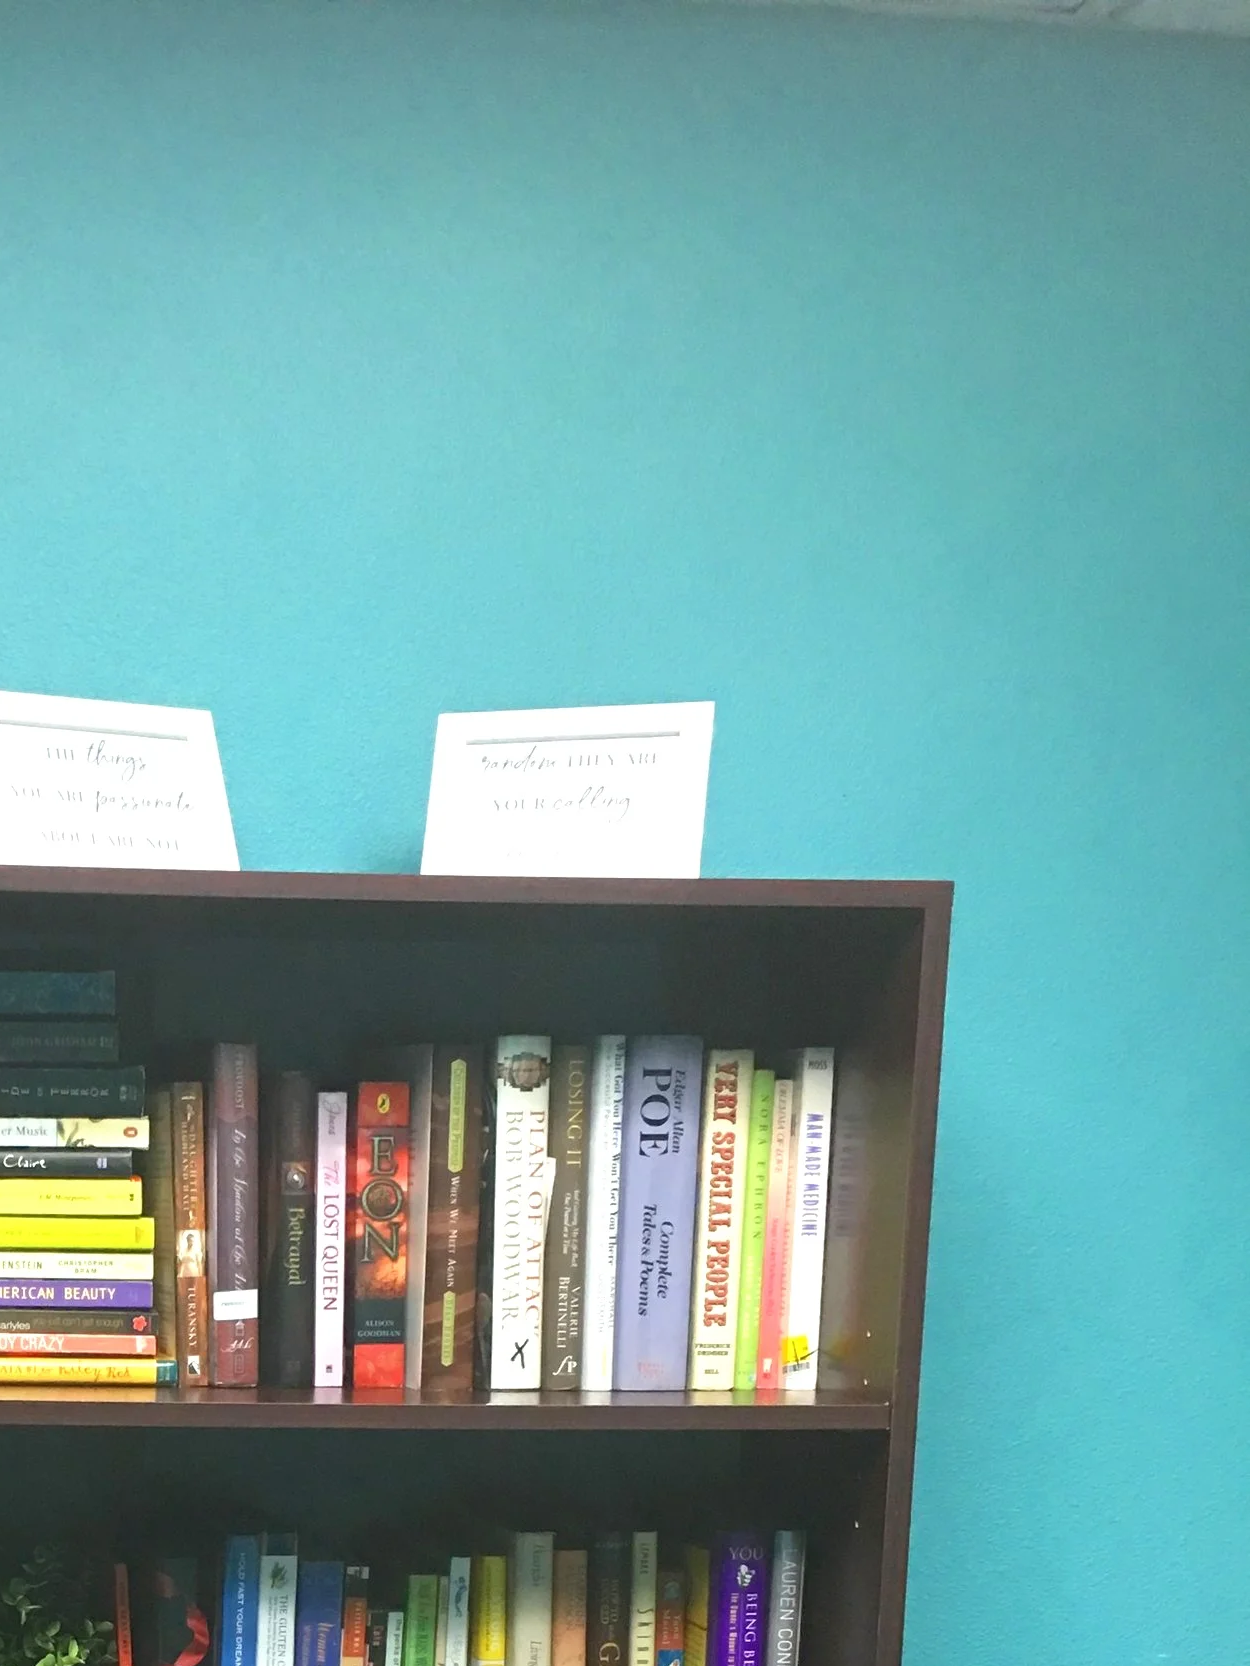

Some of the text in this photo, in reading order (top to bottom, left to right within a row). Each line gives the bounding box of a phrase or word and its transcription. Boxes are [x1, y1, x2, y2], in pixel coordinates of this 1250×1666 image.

[16, 1125, 48, 1136] Music
[505, 1111, 524, 1162] BOB
[567, 1059, 583, 1168] LOSING IT
[639, 1067, 673, 1157] POE
[671, 1070, 686, 1154] Edgar Allan
[757, 1094, 770, 1146] NORA
[3, 1153, 46, 1169] Claire
[527, 1111, 545, 1225] PLAN OF
[607, 1043, 625, 1266] What Got You Here Won't Get You There
[802, 1113, 824, 1236] MAN-MADE MEDICINE
[703, 1061, 739, 1328] VERY SPECIAL PEOPLE
[752, 1161, 768, 1240] EPHRON
[284, 1208, 306, 1286] Betrayal
[322, 1195, 338, 1310] LOST QUEEN
[637, 1204, 656, 1316] Tales & Poems
[656, 1221, 674, 1298] Complete
[64, 1288, 115, 1300] BEAUTY
[187, 1286, 197, 1347] TURANSKY
[20, 1337, 64, 1350] CRAZY
[235, 1582, 245, 1604] FAST
[235, 1607, 244, 1633] YOUR
[279, 1595, 288, 1614] THE
[744, 1593, 757, 1643] BEING
[278, 1618, 287, 1657] GLUTEN
